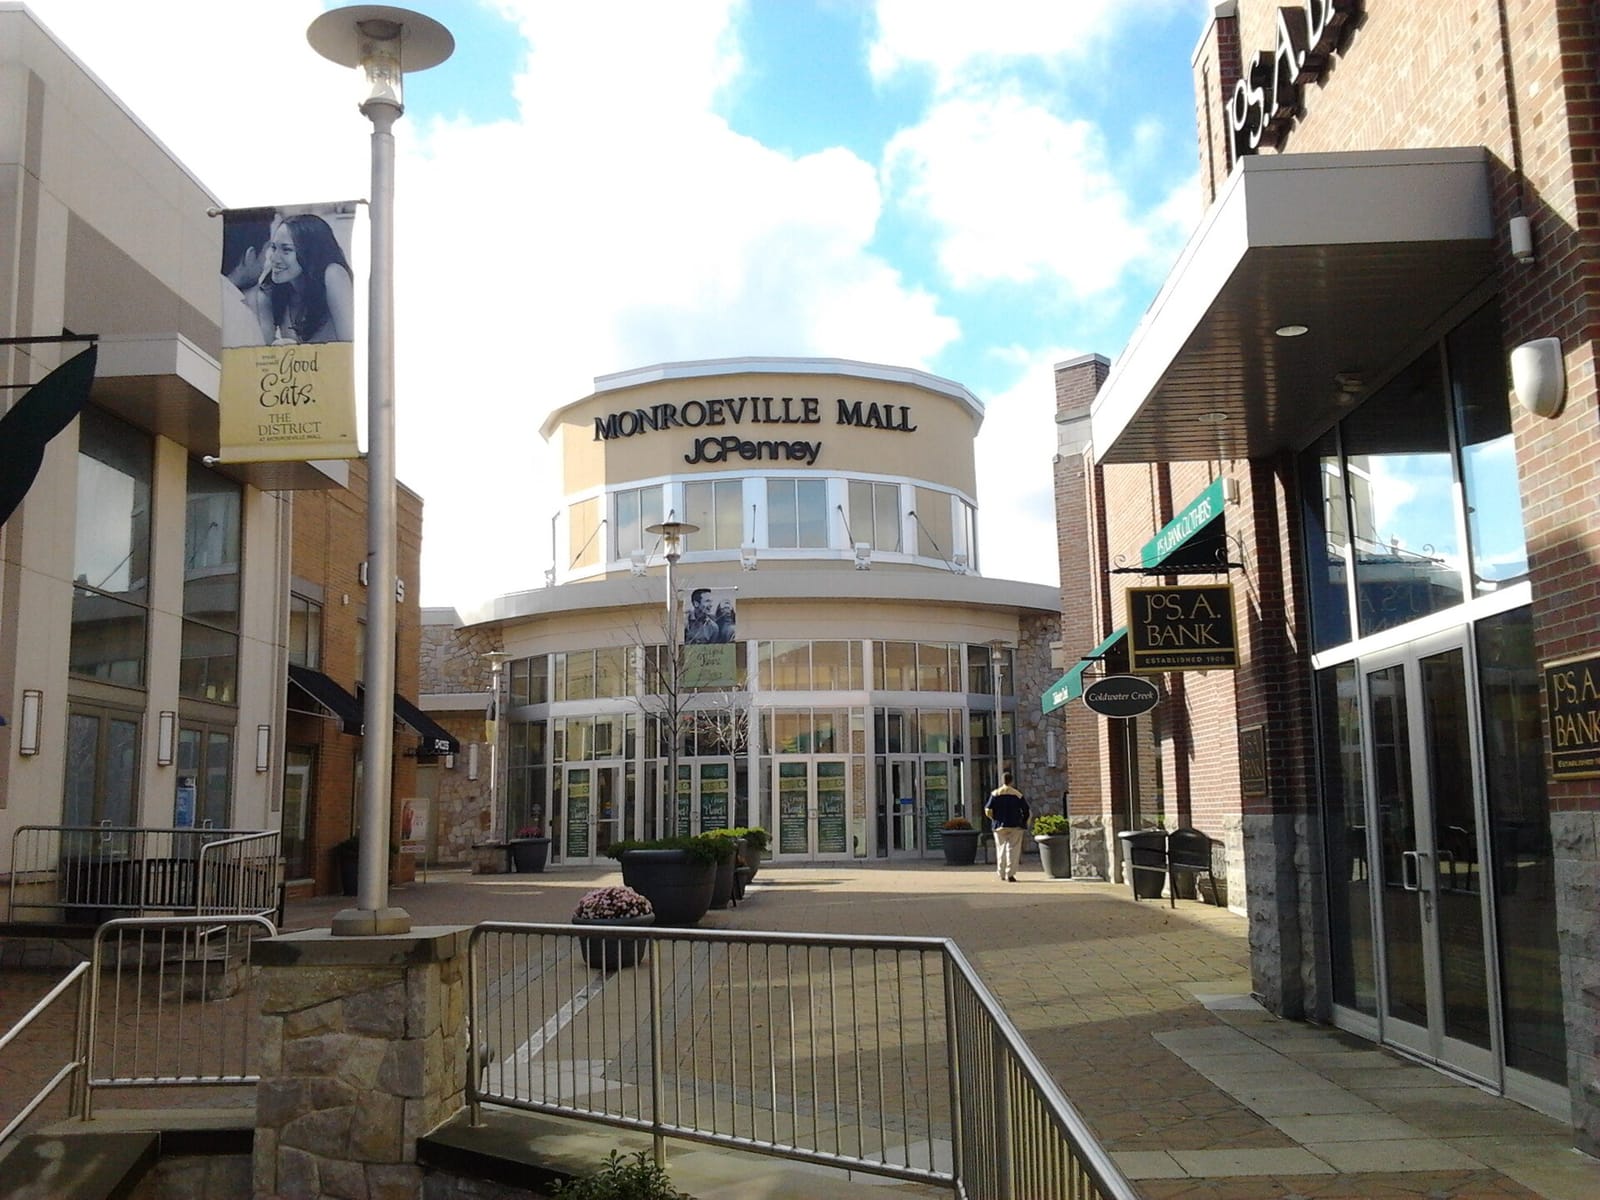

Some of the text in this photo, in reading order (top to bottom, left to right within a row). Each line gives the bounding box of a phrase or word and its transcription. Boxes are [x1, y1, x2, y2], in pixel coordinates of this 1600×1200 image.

[1271, 7, 1305, 117] A.
[280, 348, 319, 383] Good
[260, 373, 316, 407] Eats.
[257, 421, 322, 436] DISTRICT
[269, 413, 292, 423] THE
[593, 396, 917, 441] MONROEVILLE MALL
[684, 435, 822, 466] JCPenney
[1189, 593, 1222, 619] A.
[1146, 623, 1220, 647] BANK
[1145, 656, 1202, 665] ESTABLISHED
[1088, 691, 1154, 702] Coldwater Creek
